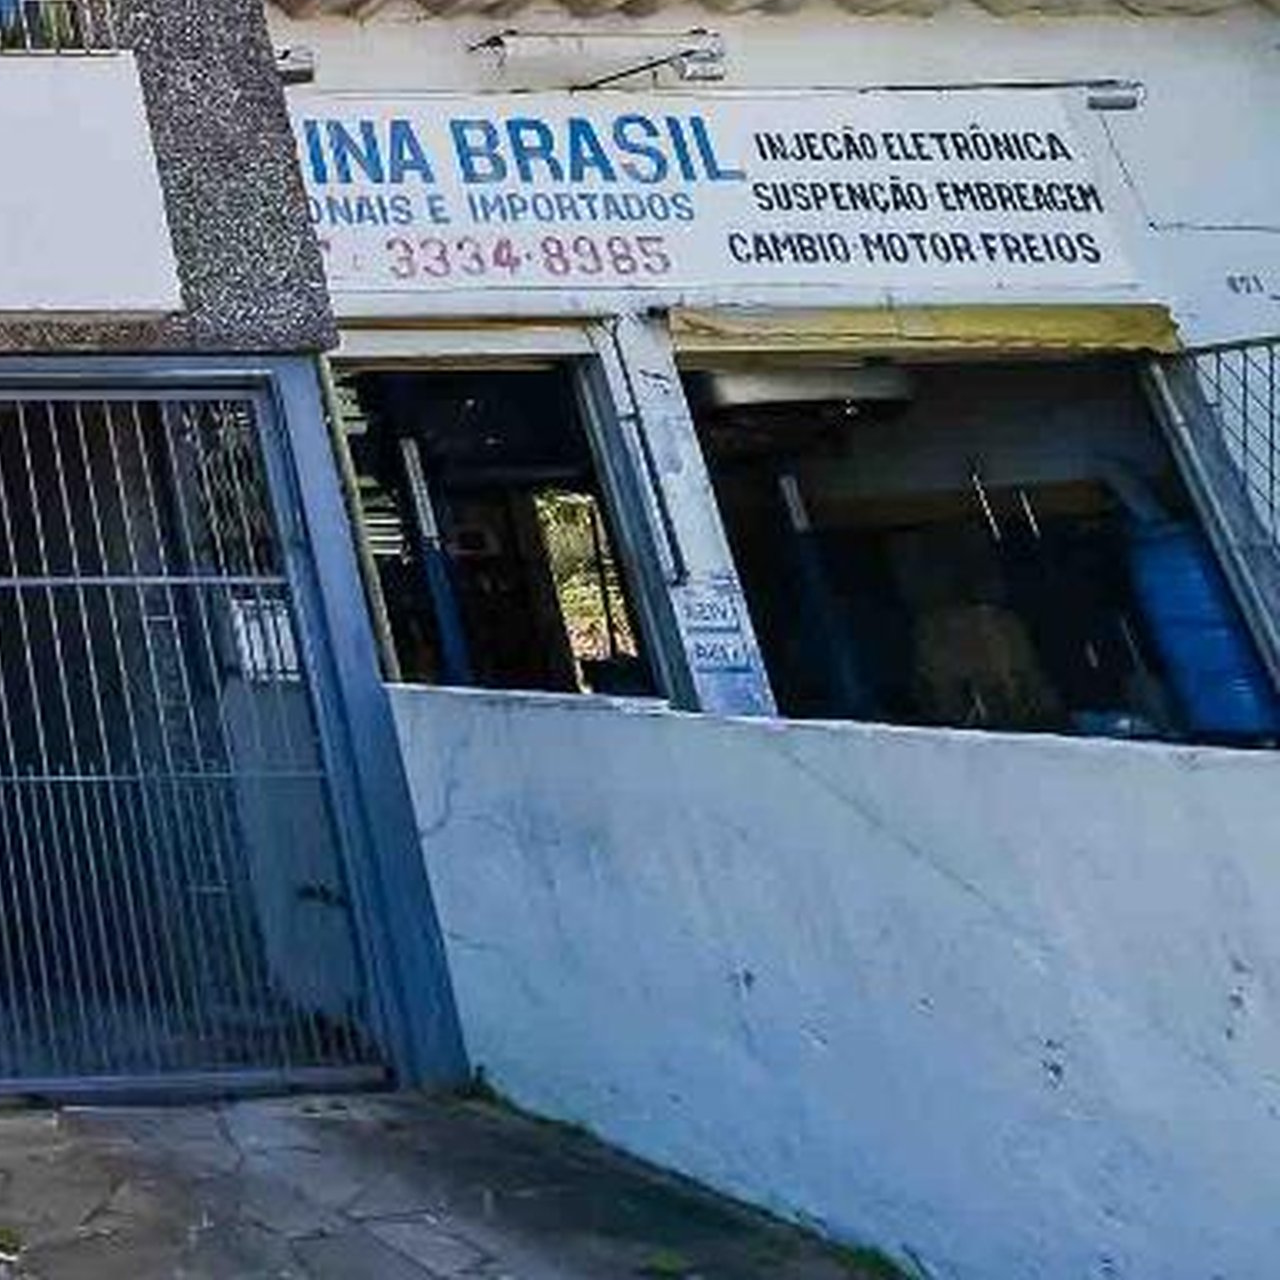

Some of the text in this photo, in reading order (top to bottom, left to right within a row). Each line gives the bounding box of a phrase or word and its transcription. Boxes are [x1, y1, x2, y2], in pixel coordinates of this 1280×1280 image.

[449, 114, 747, 184] BRASIL
[881, 123, 1073, 161] ELETRÔNICA
[428, 195, 451, 224] E
[468, 192, 695, 222] IMPORTADOS
[752, 176, 1104, 214] SUSPENÇÃO EMBREAGEM
[728, 232, 851, 263] CAMBIO
[979, 232, 1101, 263] FREIOS
